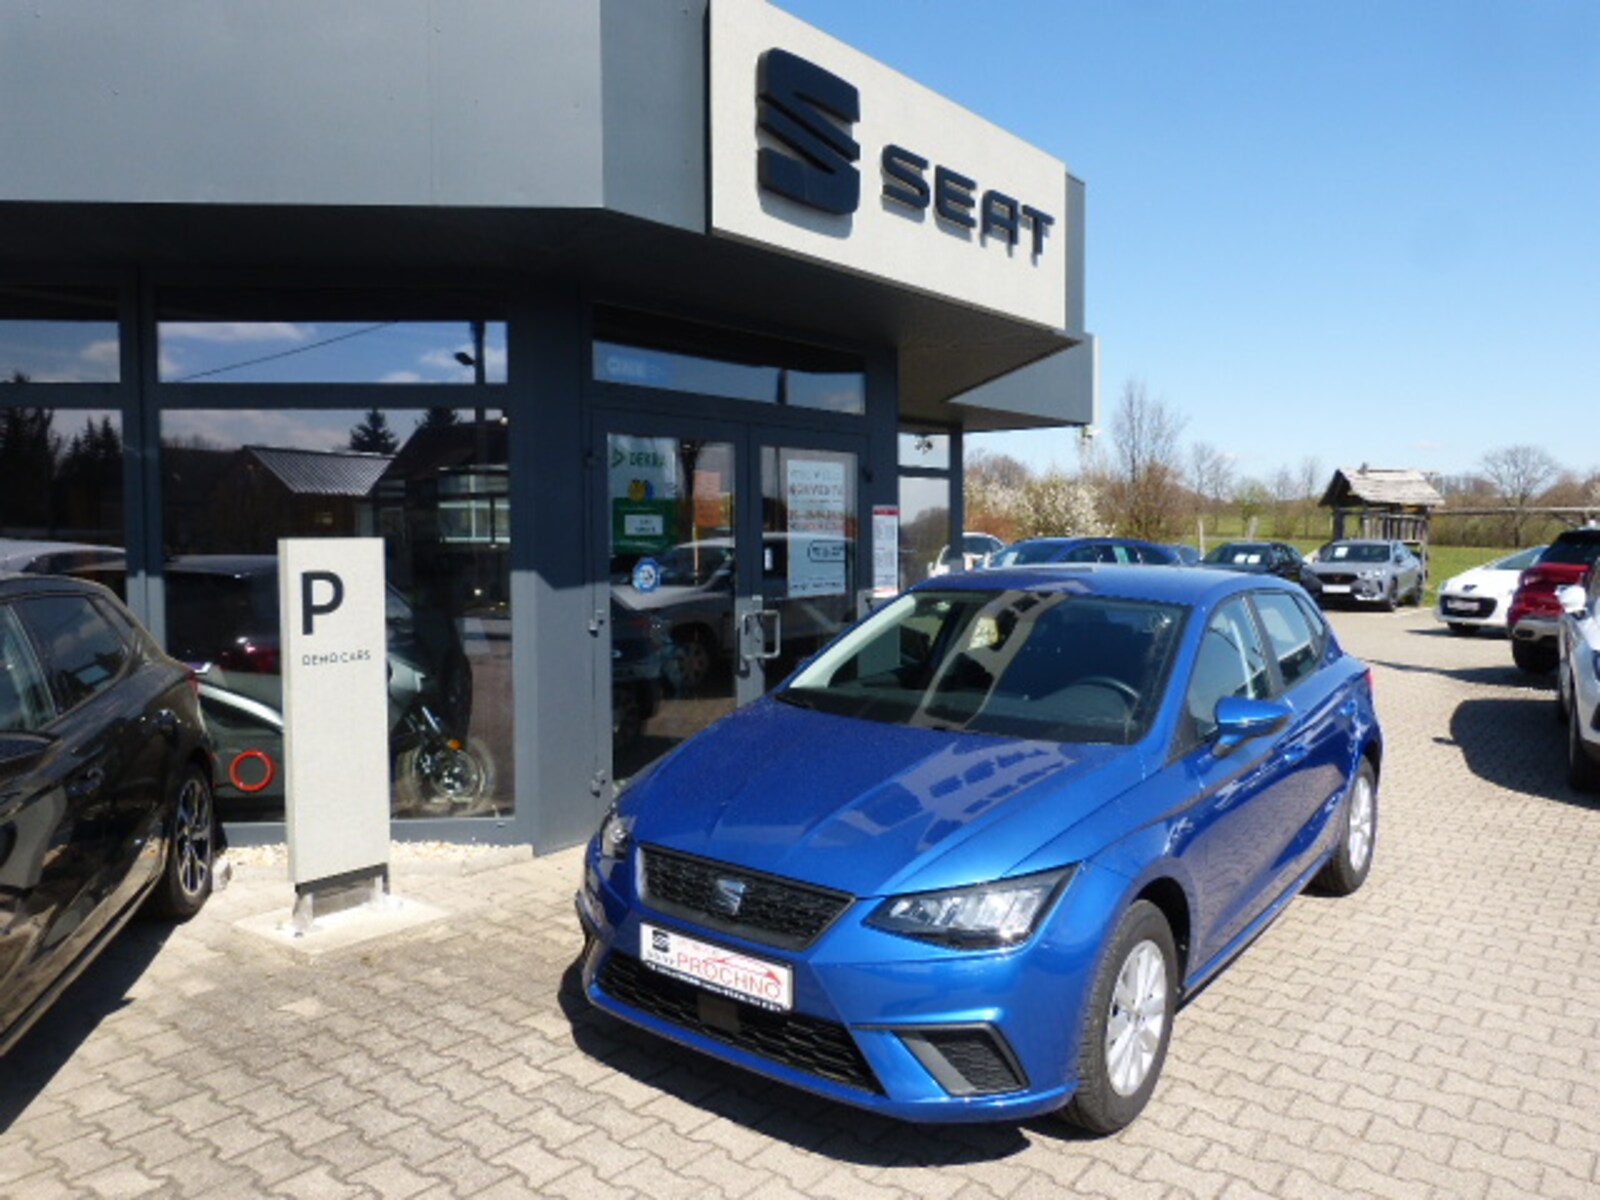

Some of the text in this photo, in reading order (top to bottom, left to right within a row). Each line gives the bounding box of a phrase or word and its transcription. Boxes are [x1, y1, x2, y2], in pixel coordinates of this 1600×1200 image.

[881, 143, 1055, 258] SEAT
[302, 571, 343, 635] P
[302, 649, 371, 666] DEMO CARS
[677, 951, 781, 999] PROCHNO
